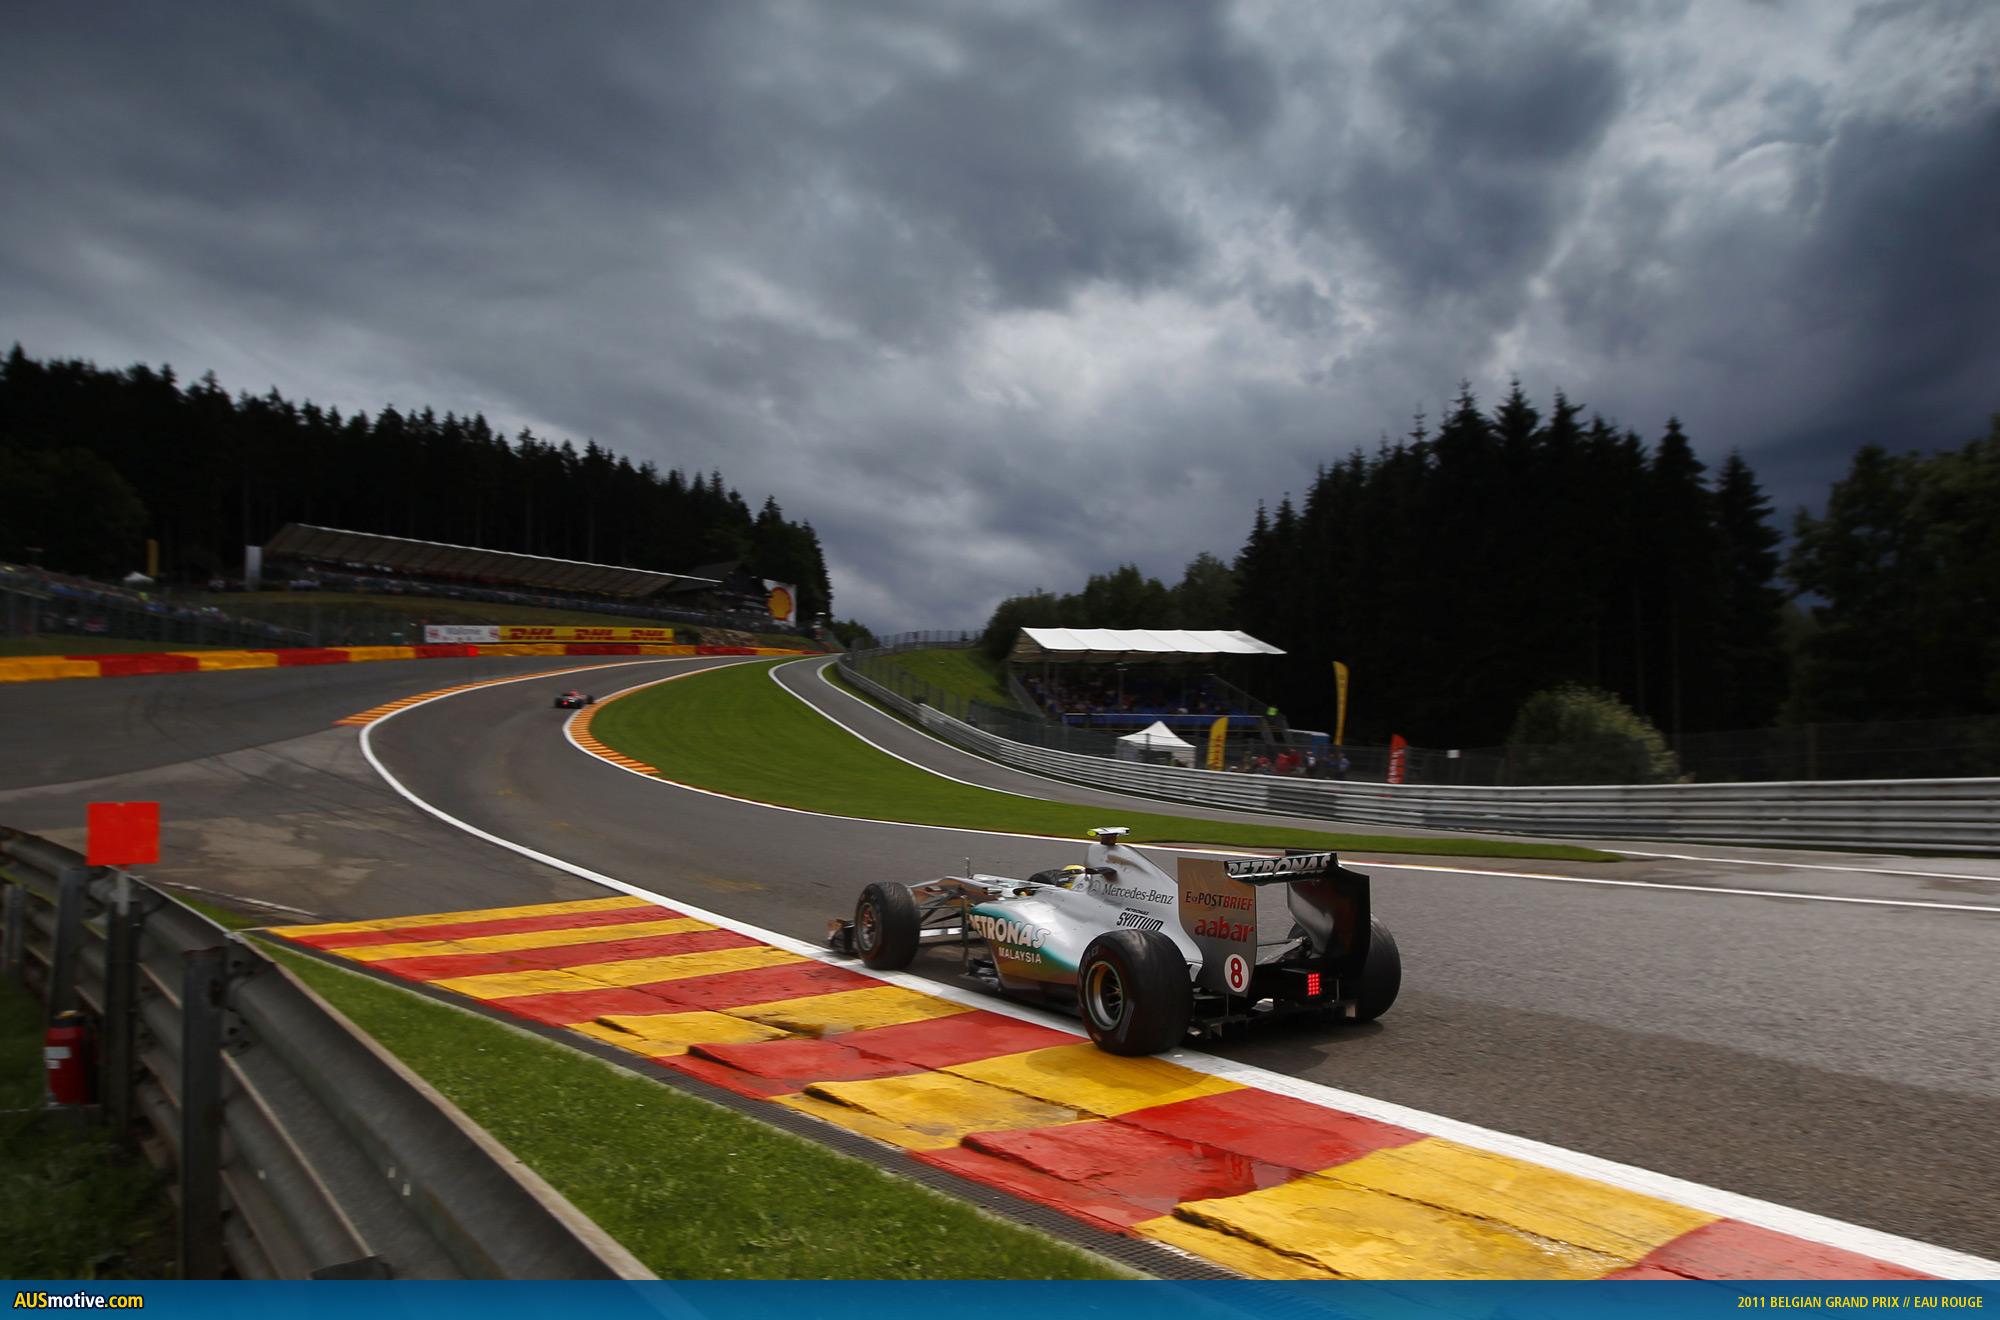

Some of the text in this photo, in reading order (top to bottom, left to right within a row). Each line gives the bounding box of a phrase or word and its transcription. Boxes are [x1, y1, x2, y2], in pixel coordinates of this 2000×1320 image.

[509, 627, 665, 640] DHL DHL DHL
[1102, 883, 1174, 905] Mercedes-Benz
[1194, 916, 1255, 943] aabar
[998, 947, 1042, 964] MALAYSIA
[1230, 957, 1243, 989] 8
